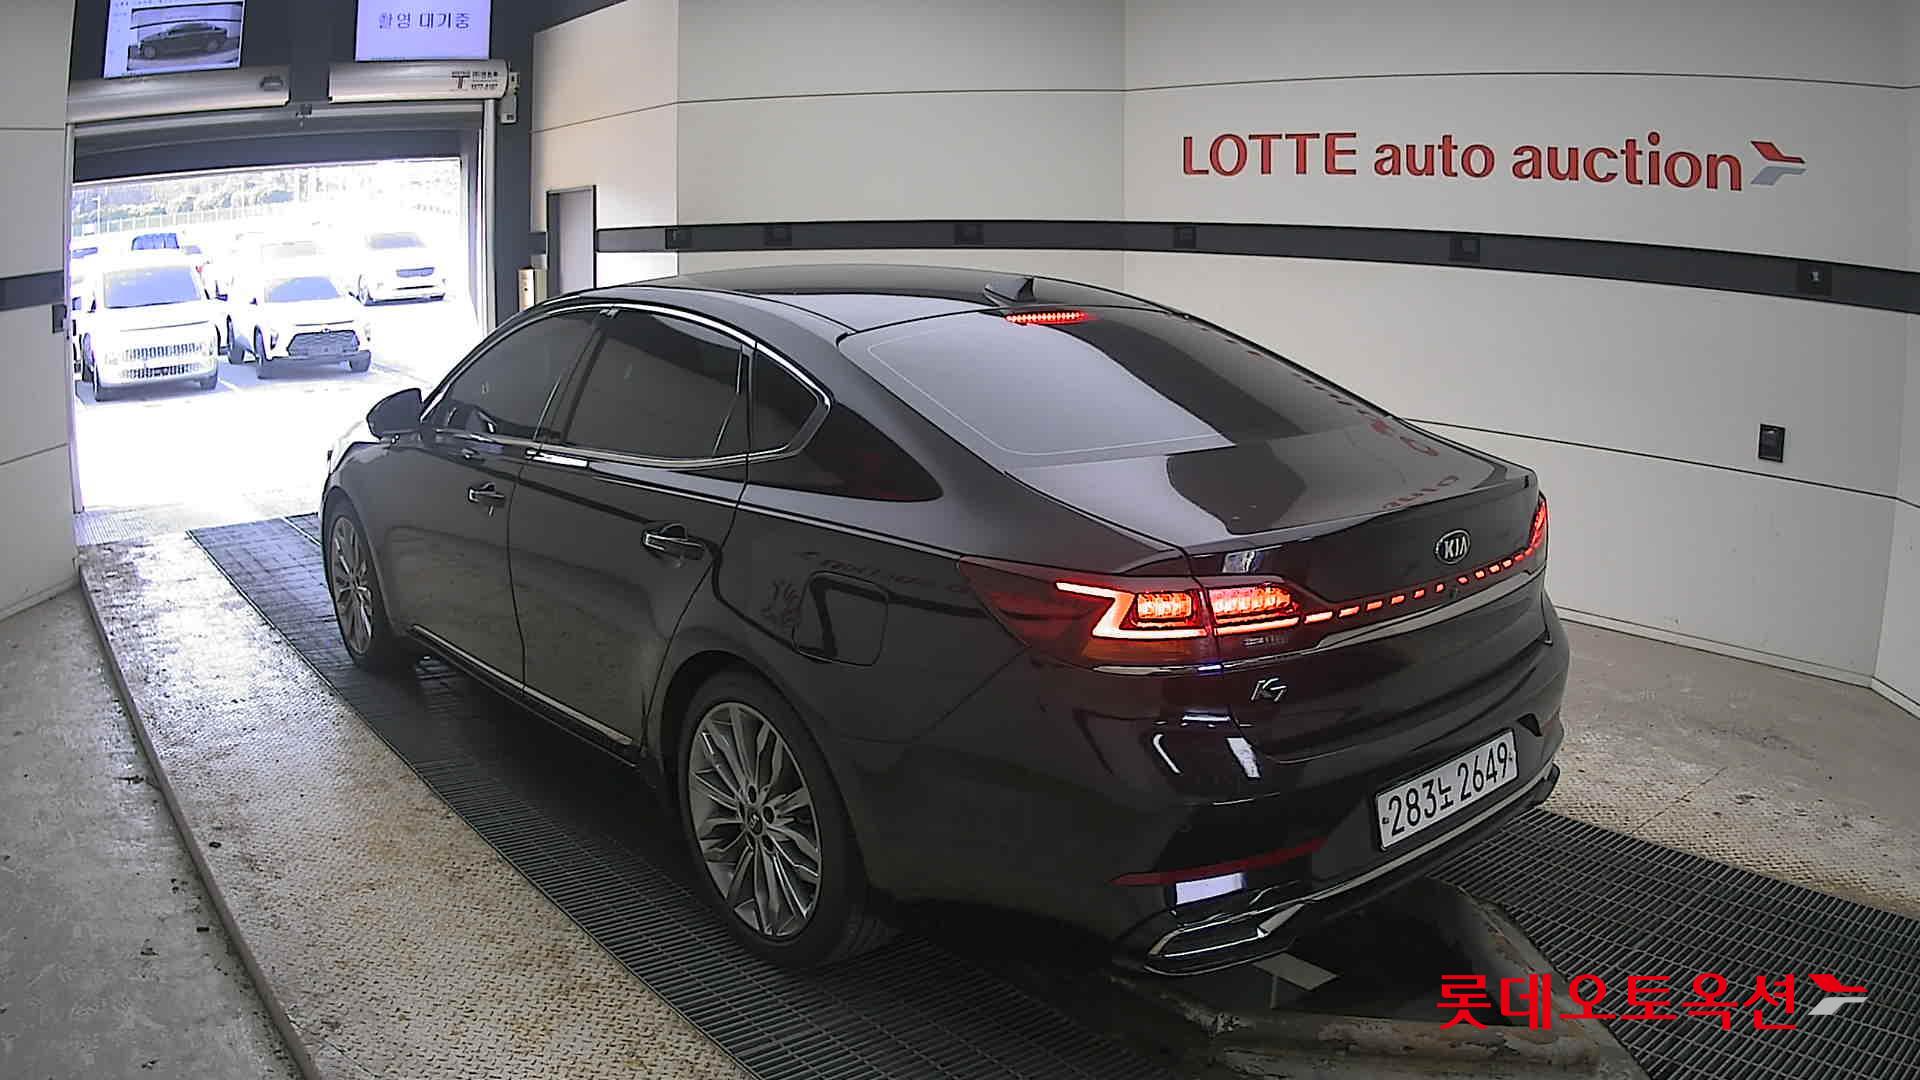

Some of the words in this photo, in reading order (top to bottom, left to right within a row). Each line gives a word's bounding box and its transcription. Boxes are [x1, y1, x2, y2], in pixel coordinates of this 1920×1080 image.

[419, 12, 471, 29] 대기중
[1183, 132, 1358, 177] LOTTE
[1374, 133, 1496, 178] auto
[1511, 131, 1743, 192] auction
[1443, 535, 1468, 560] KIA
[1250, 677, 1288, 702] K7
[1388, 776, 1454, 837] 283노
[1457, 741, 1509, 802] 2649
